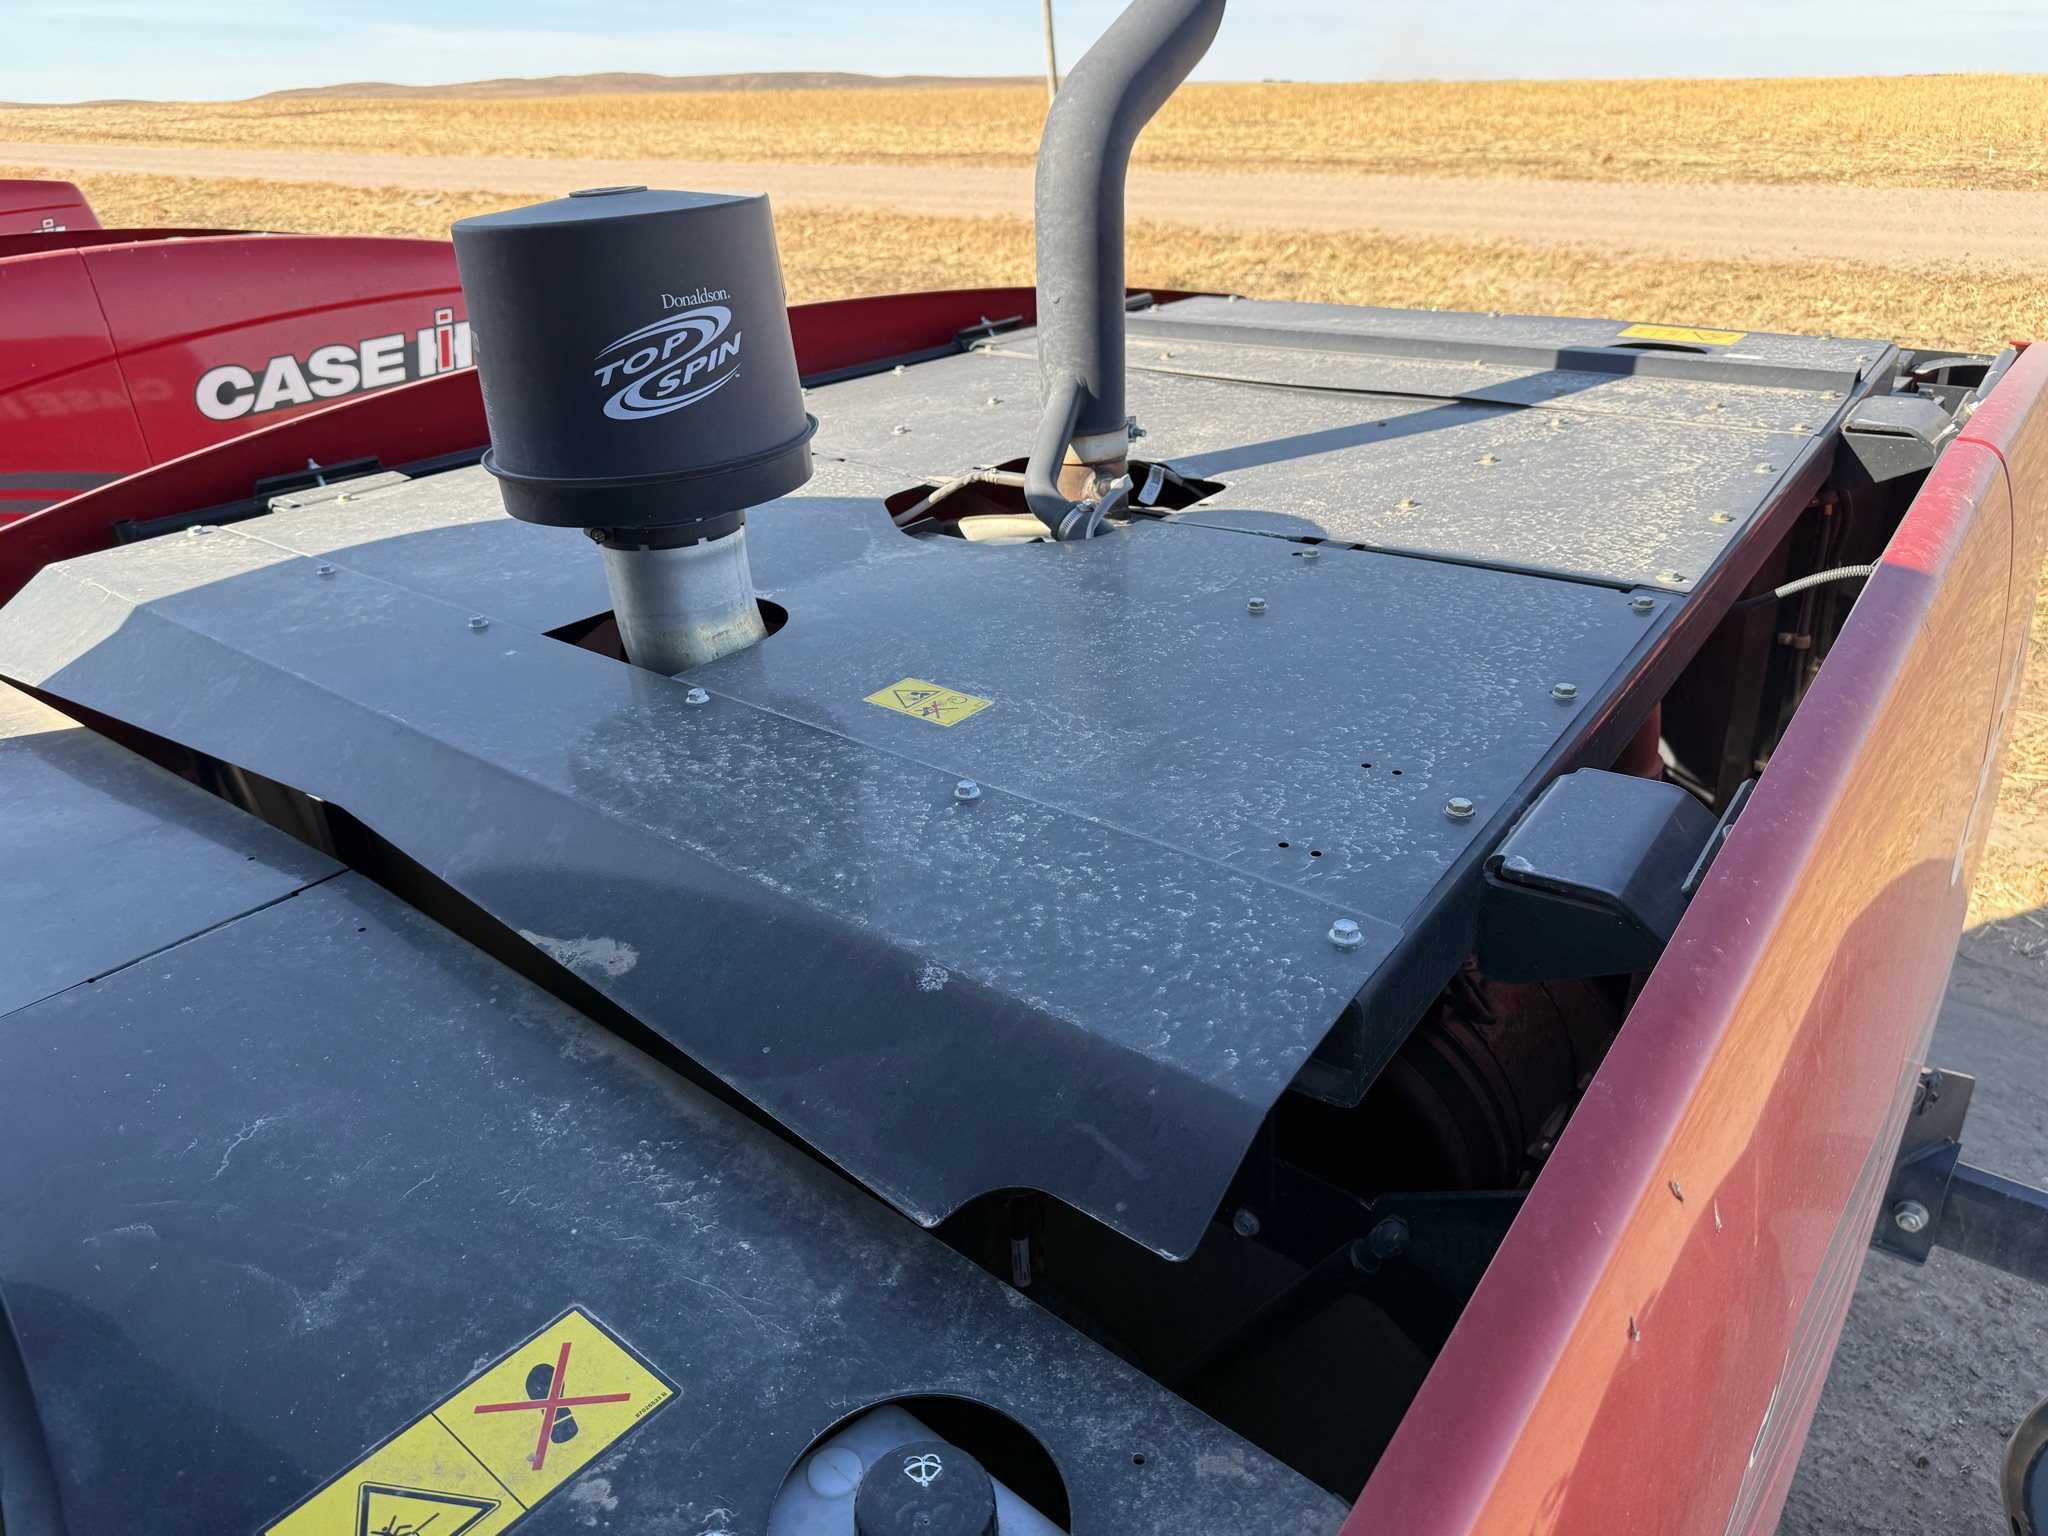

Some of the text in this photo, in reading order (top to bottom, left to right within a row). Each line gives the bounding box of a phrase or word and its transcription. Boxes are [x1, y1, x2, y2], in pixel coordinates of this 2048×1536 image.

[196, 334, 406, 420] CASE
[594, 330, 688, 387] TOP
[656, 331, 742, 397] SPIN
